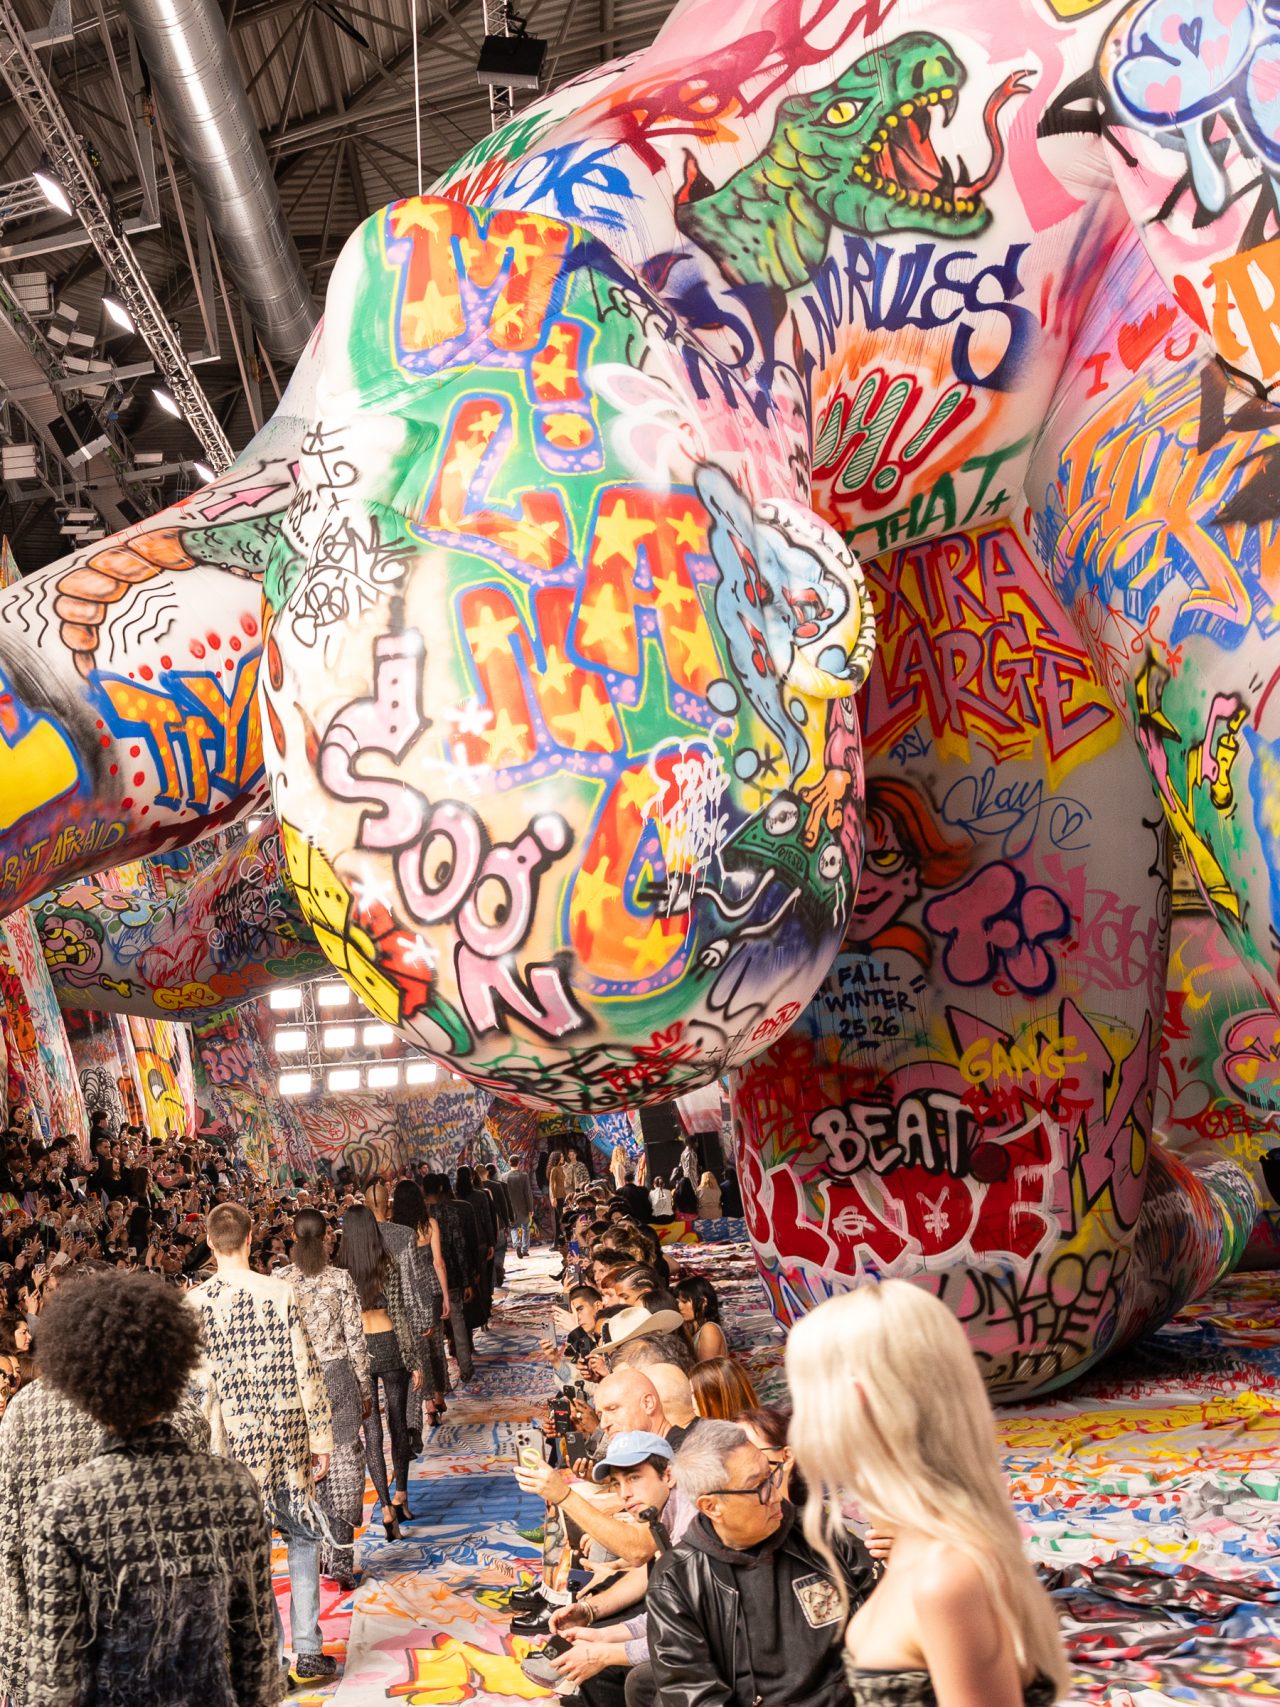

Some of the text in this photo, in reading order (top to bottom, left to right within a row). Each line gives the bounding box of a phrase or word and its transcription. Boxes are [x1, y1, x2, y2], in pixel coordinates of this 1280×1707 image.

[863, 526, 1091, 658] XTRA
[856, 611, 1116, 762] LARGE
[41, 817, 128, 876] AFRAID
[824, 987, 917, 1014] WINTER
[837, 961, 901, 988] FALL
[838, 1015, 901, 1041] 25 26
[959, 1035, 1089, 1084] GANG
[810, 1087, 974, 1178] BEAT
